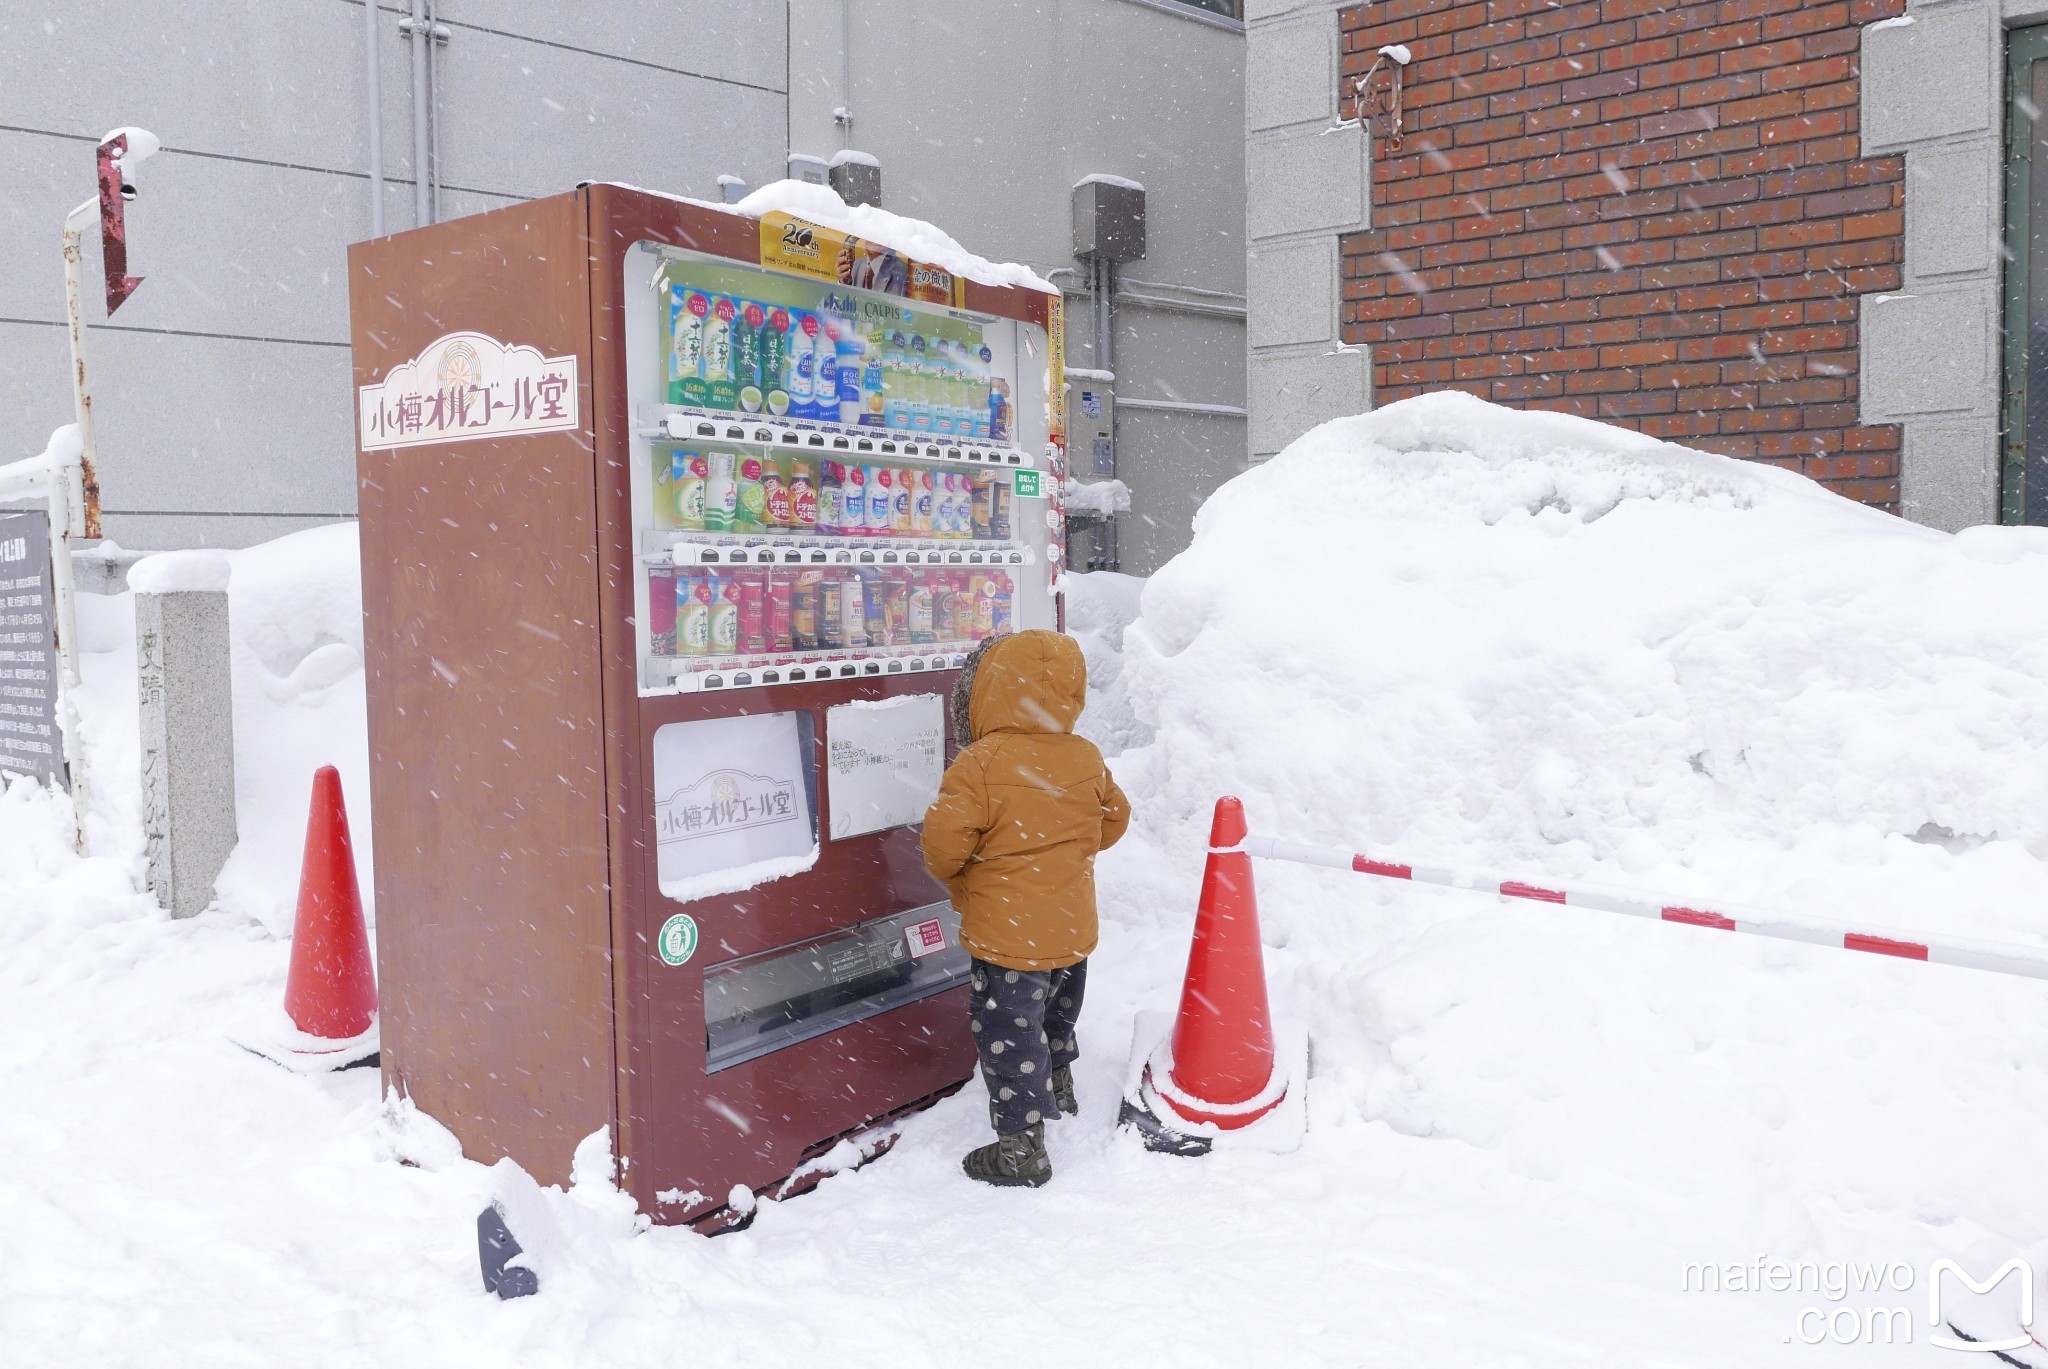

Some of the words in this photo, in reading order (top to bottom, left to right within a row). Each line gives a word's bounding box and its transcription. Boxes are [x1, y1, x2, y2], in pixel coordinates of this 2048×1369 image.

[783, 245, 819, 259] Anniversary
[865, 302, 900, 320] CALPIS
[741, 335, 753, 366] 日本茶
[767, 338, 779, 372] 日本茶
[370, 372, 568, 438] 小樽オルゴール堂
[662, 790, 791, 834] 小樽オルゴール堂
